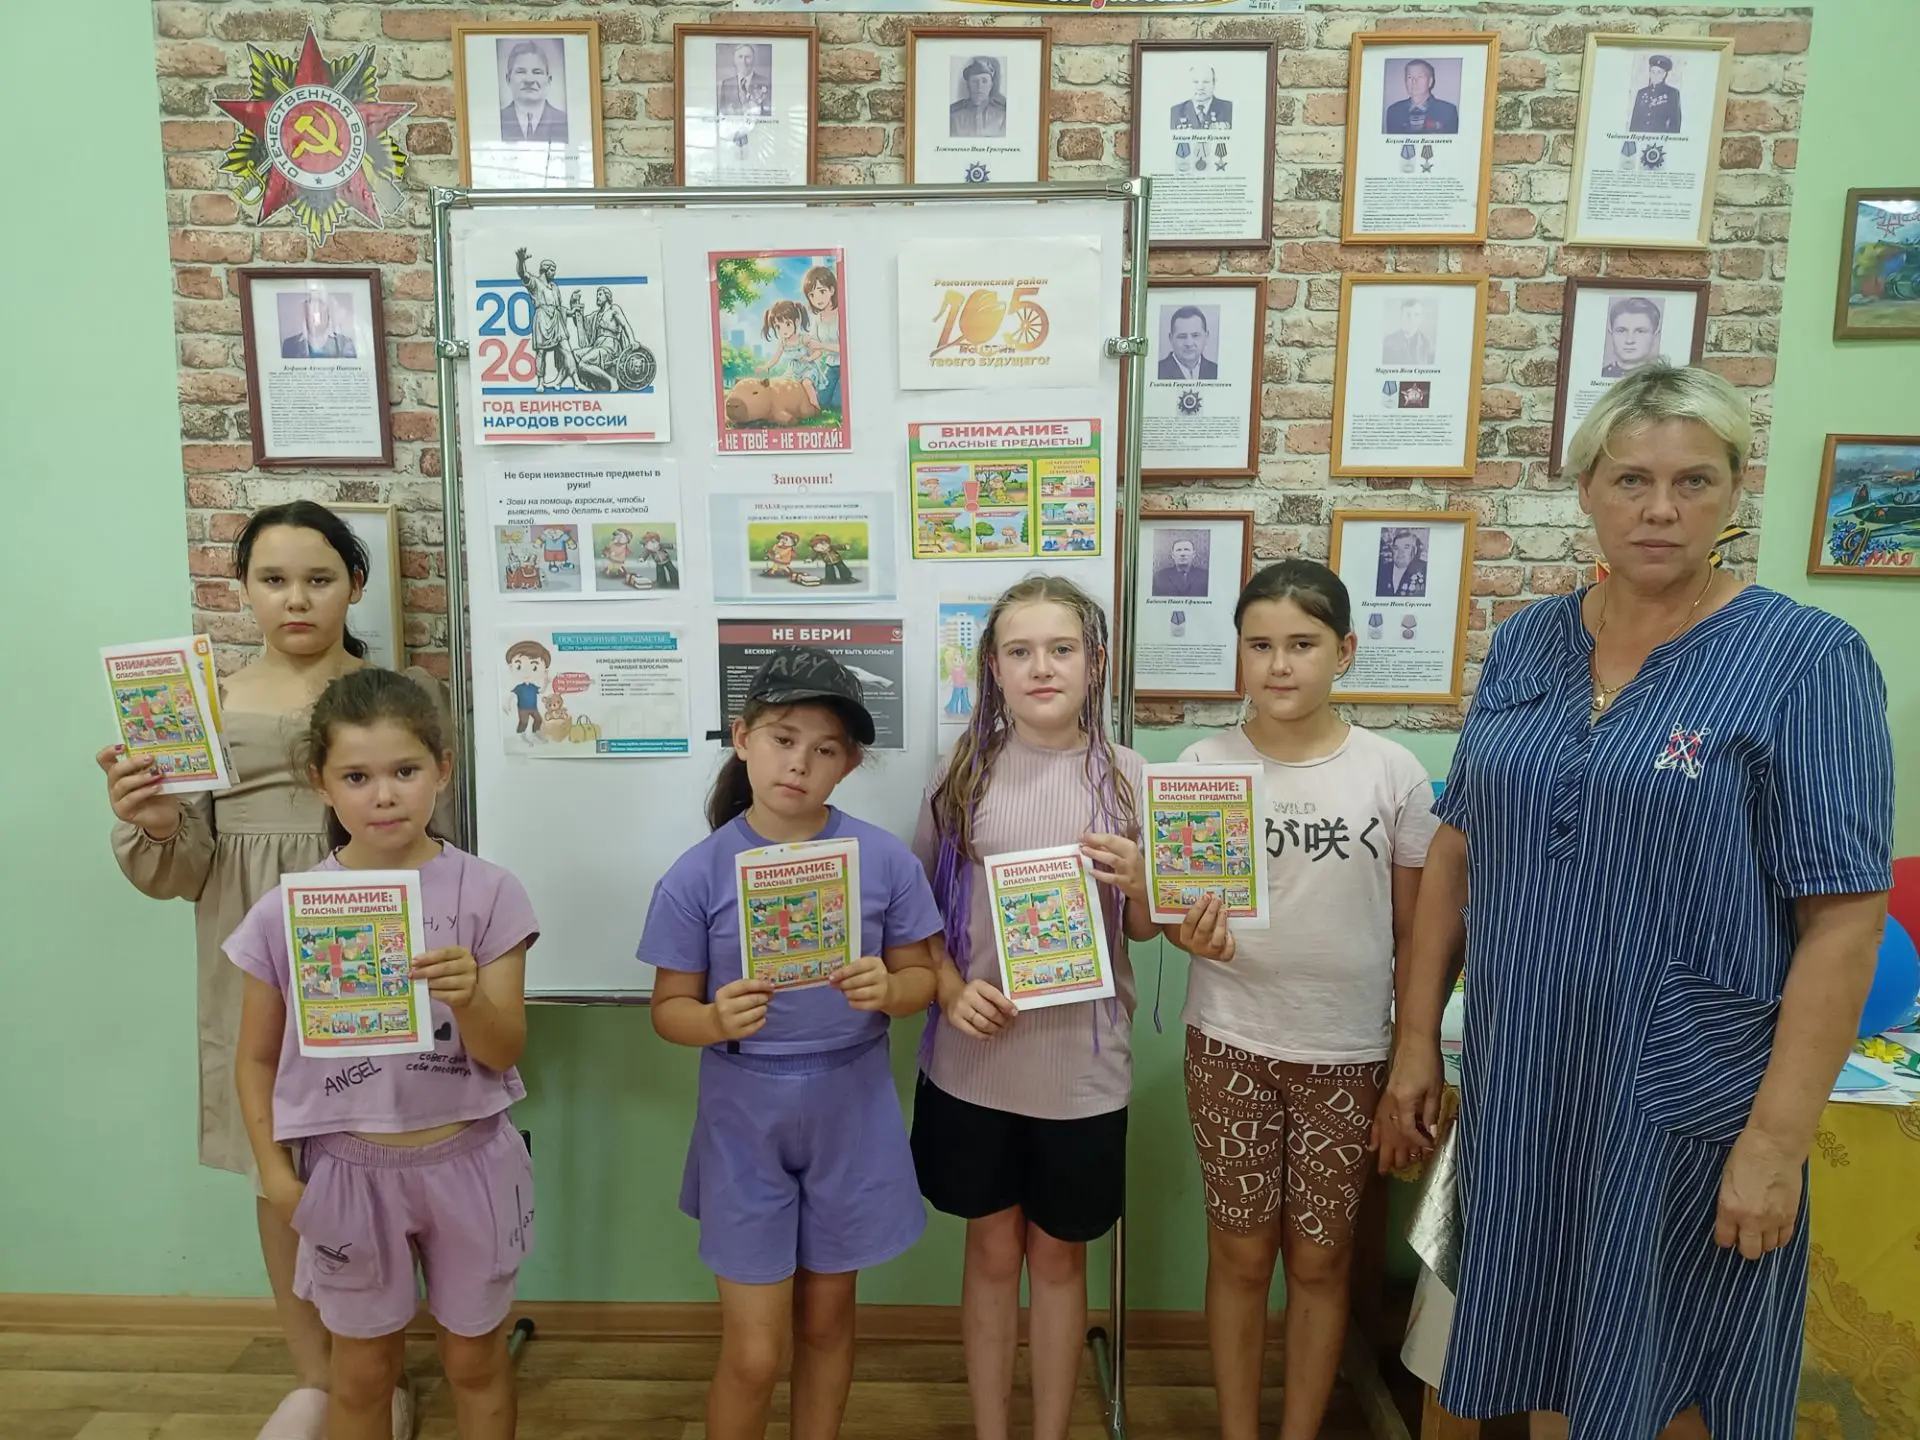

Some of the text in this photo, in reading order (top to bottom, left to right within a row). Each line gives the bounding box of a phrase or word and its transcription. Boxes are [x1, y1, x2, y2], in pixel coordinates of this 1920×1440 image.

[476, 291, 535, 337] 20
[478, 338, 537, 382] 26
[483, 400, 603, 414] ГОД ЕДИНСТВА
[483, 415, 628, 429] НАРОДОВ РОССИИ
[725, 431, 738, 450] НЕ
[742, 429, 769, 449] ТВОЁ
[781, 431, 794, 449] НЕ
[797, 428, 843, 449] ТРОГАЙ!
[940, 425, 1070, 438] ВНИМАНИЕ:
[928, 437, 1084, 450] ОПАСНЫЕ ПРЕДМЕТЫ!
[504, 470, 661, 482] Не бери неизвестные предметы в
[771, 472, 834, 486] Запомни!
[567, 481, 592, 491] руки!
[506, 498, 527, 506] Зови
[540, 498, 573, 507] помощь
[616, 496, 646, 504] чтобы
[552, 507, 570, 515] что
[571, 505, 603, 515] делать
[772, 628, 852, 641] НЕ БЕРИ!
[1160, 781, 1240, 793] ВНИМАНИЕ:
[755, 861, 836, 881] ВНИМАНИЕ:
[1003, 860, 1072, 878] ВНИМАНИЕ:
[302, 891, 393, 905] ВНИМАНИЕ:
[1203, 1036, 1260, 1062] Dior
[324, 1057, 382, 1097] ANGEL
[1223, 1070, 1278, 1102] Dior
[1323, 1087, 1372, 1130] Dior
[1217, 1135, 1279, 1158] Dior
[1288, 1165, 1340, 1210] Dior
[1206, 1180, 1254, 1219] Dior
